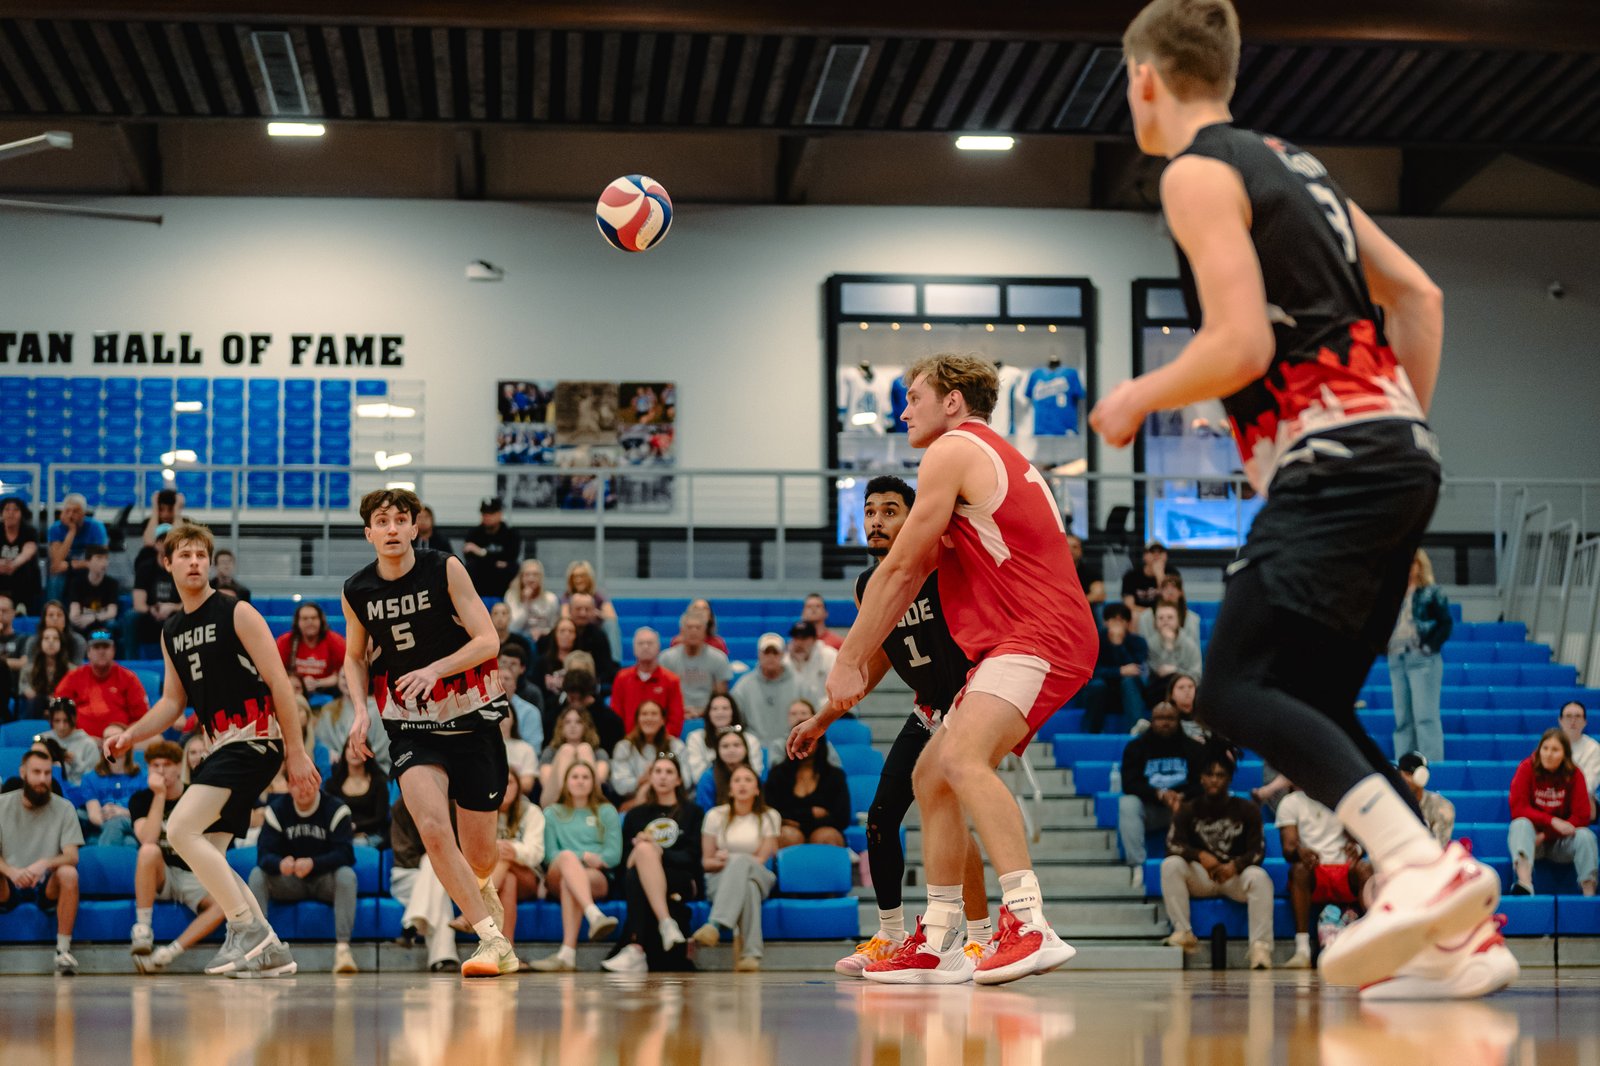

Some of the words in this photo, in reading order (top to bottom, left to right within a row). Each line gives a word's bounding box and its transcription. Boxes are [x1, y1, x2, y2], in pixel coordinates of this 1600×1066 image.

[93, 333, 201, 364] HALL
[222, 334, 271, 365] OF
[291, 336, 402, 366] FAME
[366, 589, 432, 621] MSOE
[897, 597, 934, 628] OE
[172, 623, 217, 655] MSOE
[391, 621, 416, 651] 5
[903, 635, 932, 668] 1
[187, 652, 203, 681] 2
